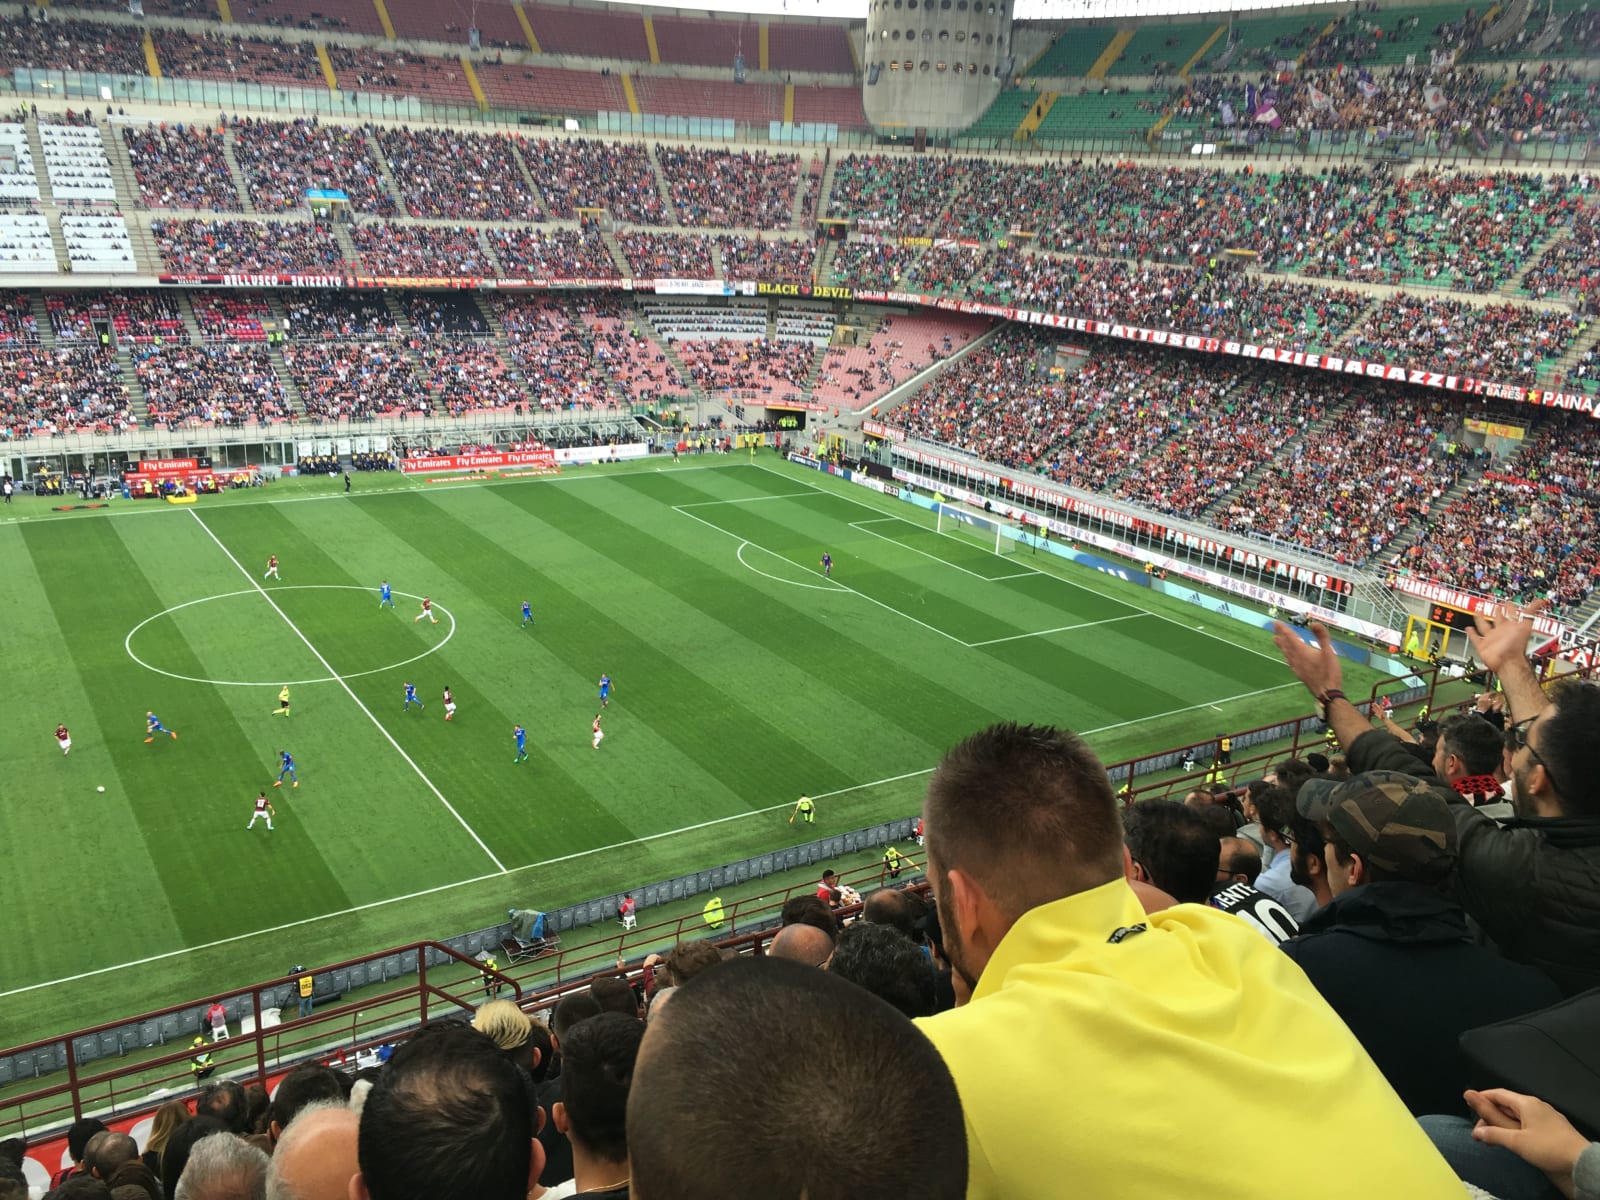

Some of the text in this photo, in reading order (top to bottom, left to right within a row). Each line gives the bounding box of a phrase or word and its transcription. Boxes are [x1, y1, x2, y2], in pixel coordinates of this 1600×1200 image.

[759, 283, 798, 295] BLACK
[813, 286, 852, 298] DEVIL
[1016, 309, 1086, 331] GRAZIE
[1097, 322, 1200, 349] GATTUSO
[1224, 341, 1458, 389] GRAZIE RAGAZZI
[1486, 388, 1524, 400] BARESI
[417, 459, 450, 468] Emirates
[456, 455, 503, 466] Fly Emirates
[508, 452, 552, 462] Fly Emirates
[143, 460, 193, 471] Fly Emirates
[1012, 481, 1033, 498] MILAN
[1034, 488, 1067, 508] ACADEMY
[1166, 529, 1226, 557] FAMILY
[1234, 549, 1268, 569] DAY
